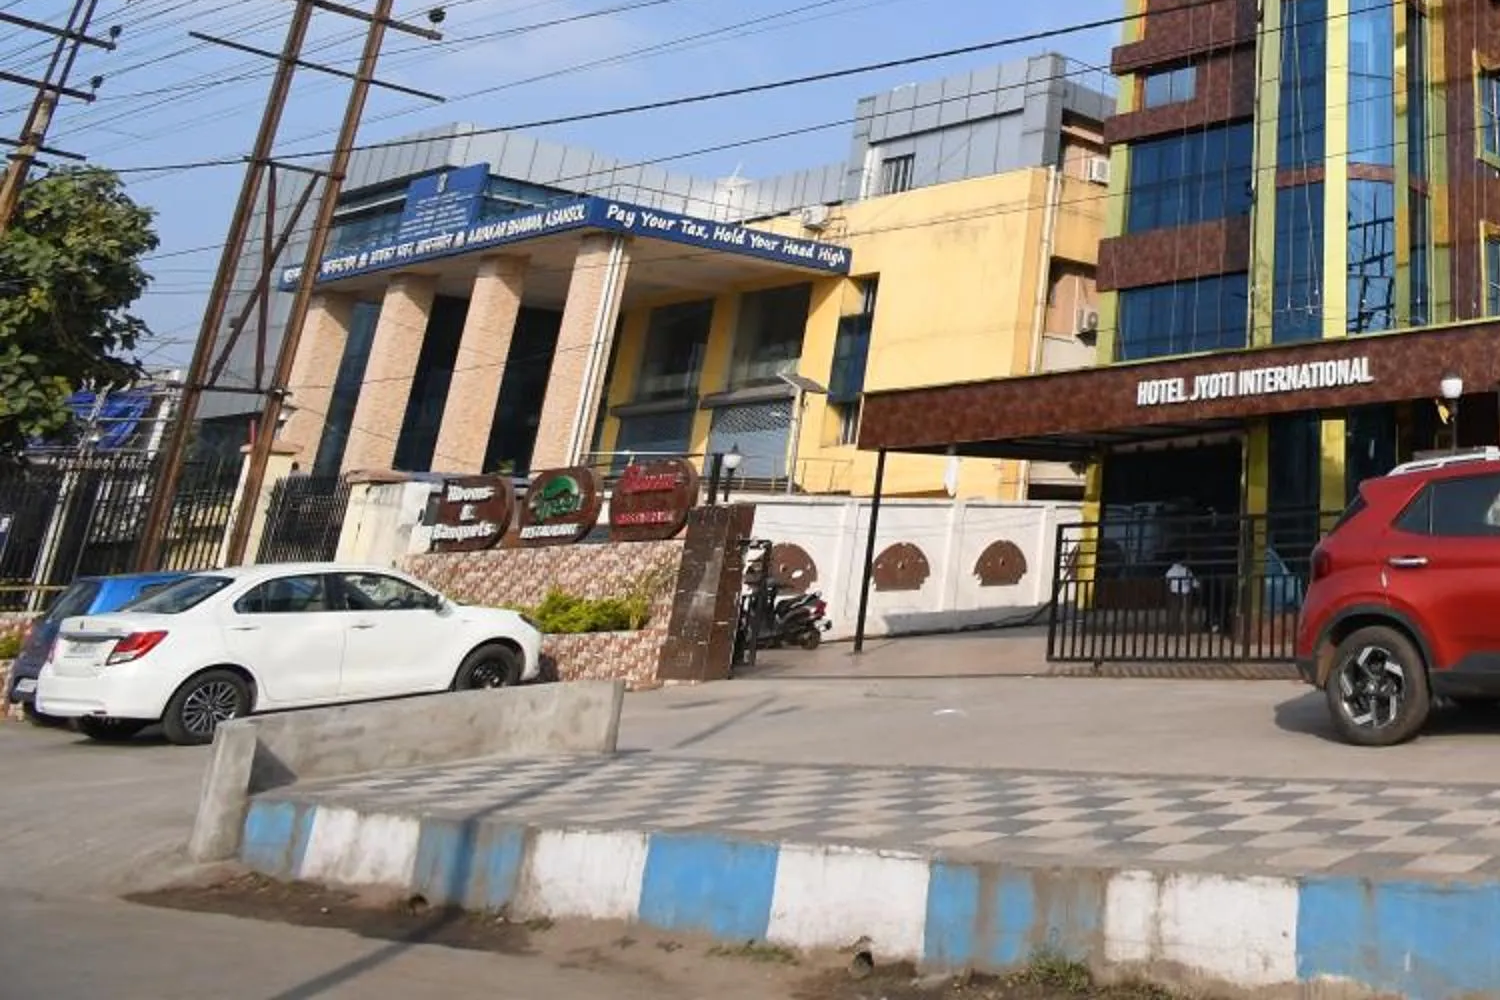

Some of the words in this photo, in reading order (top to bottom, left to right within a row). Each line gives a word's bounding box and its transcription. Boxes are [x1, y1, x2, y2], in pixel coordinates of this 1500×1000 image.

[606, 203, 635, 230] Pay
[641, 211, 674, 232] Your
[680, 219, 709, 240] Tax,
[713, 226, 745, 246] Hold
[750, 234, 779, 252] Your
[782, 240, 814, 260] Head
[818, 247, 846, 268] High
[1137, 377, 1188, 405] HOTEL
[1189, 370, 1237, 400] JYOTI
[1238, 356, 1375, 395] INTERNATIONAL
